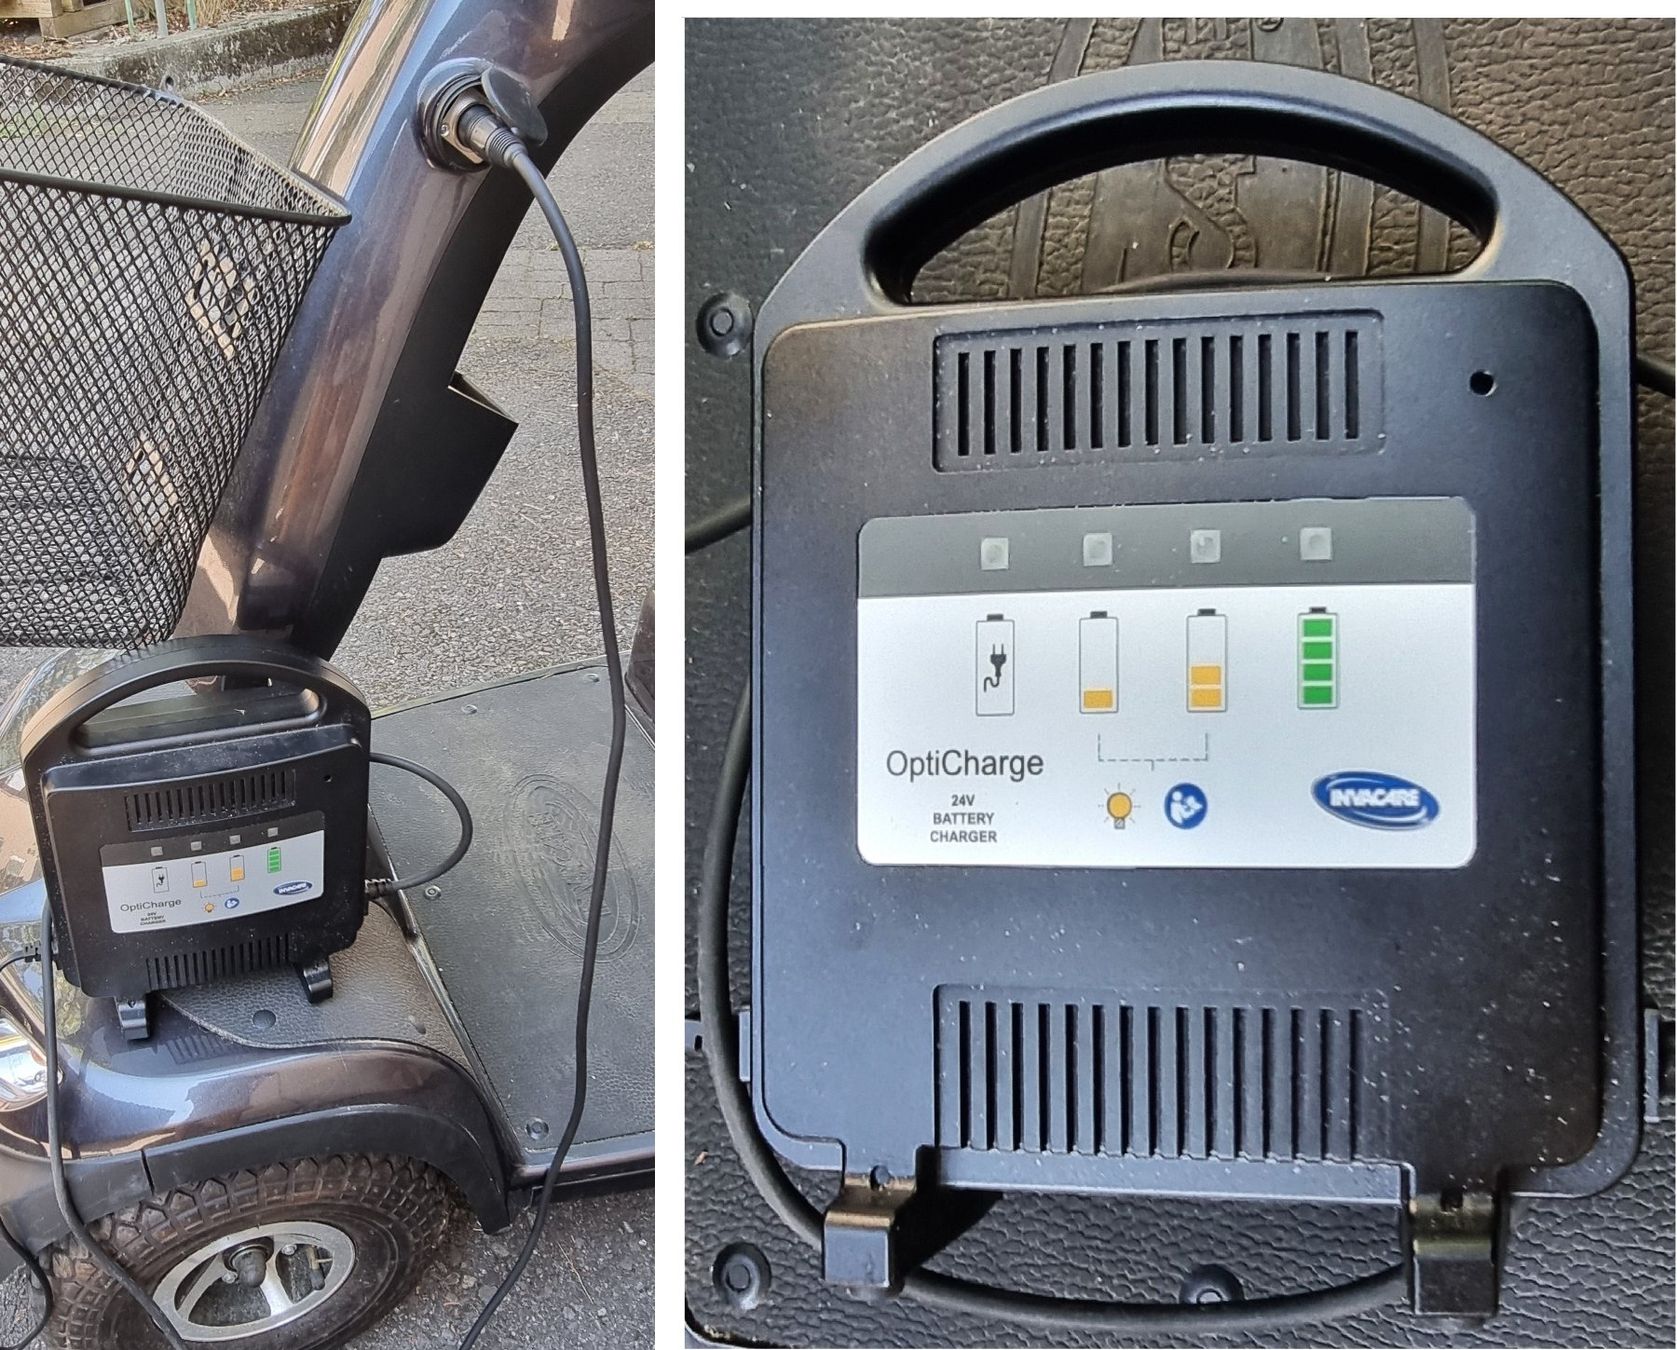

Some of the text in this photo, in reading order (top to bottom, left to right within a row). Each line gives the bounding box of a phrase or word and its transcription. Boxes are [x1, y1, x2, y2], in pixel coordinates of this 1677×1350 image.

[886, 749, 1044, 783] OptiCharge
[951, 794, 976, 807] 24V
[1329, 788, 1420, 807] INVACARE
[933, 812, 995, 825] BATTERY
[930, 830, 998, 843] CHARGER
[120, 899, 182, 912] OptiCharge
